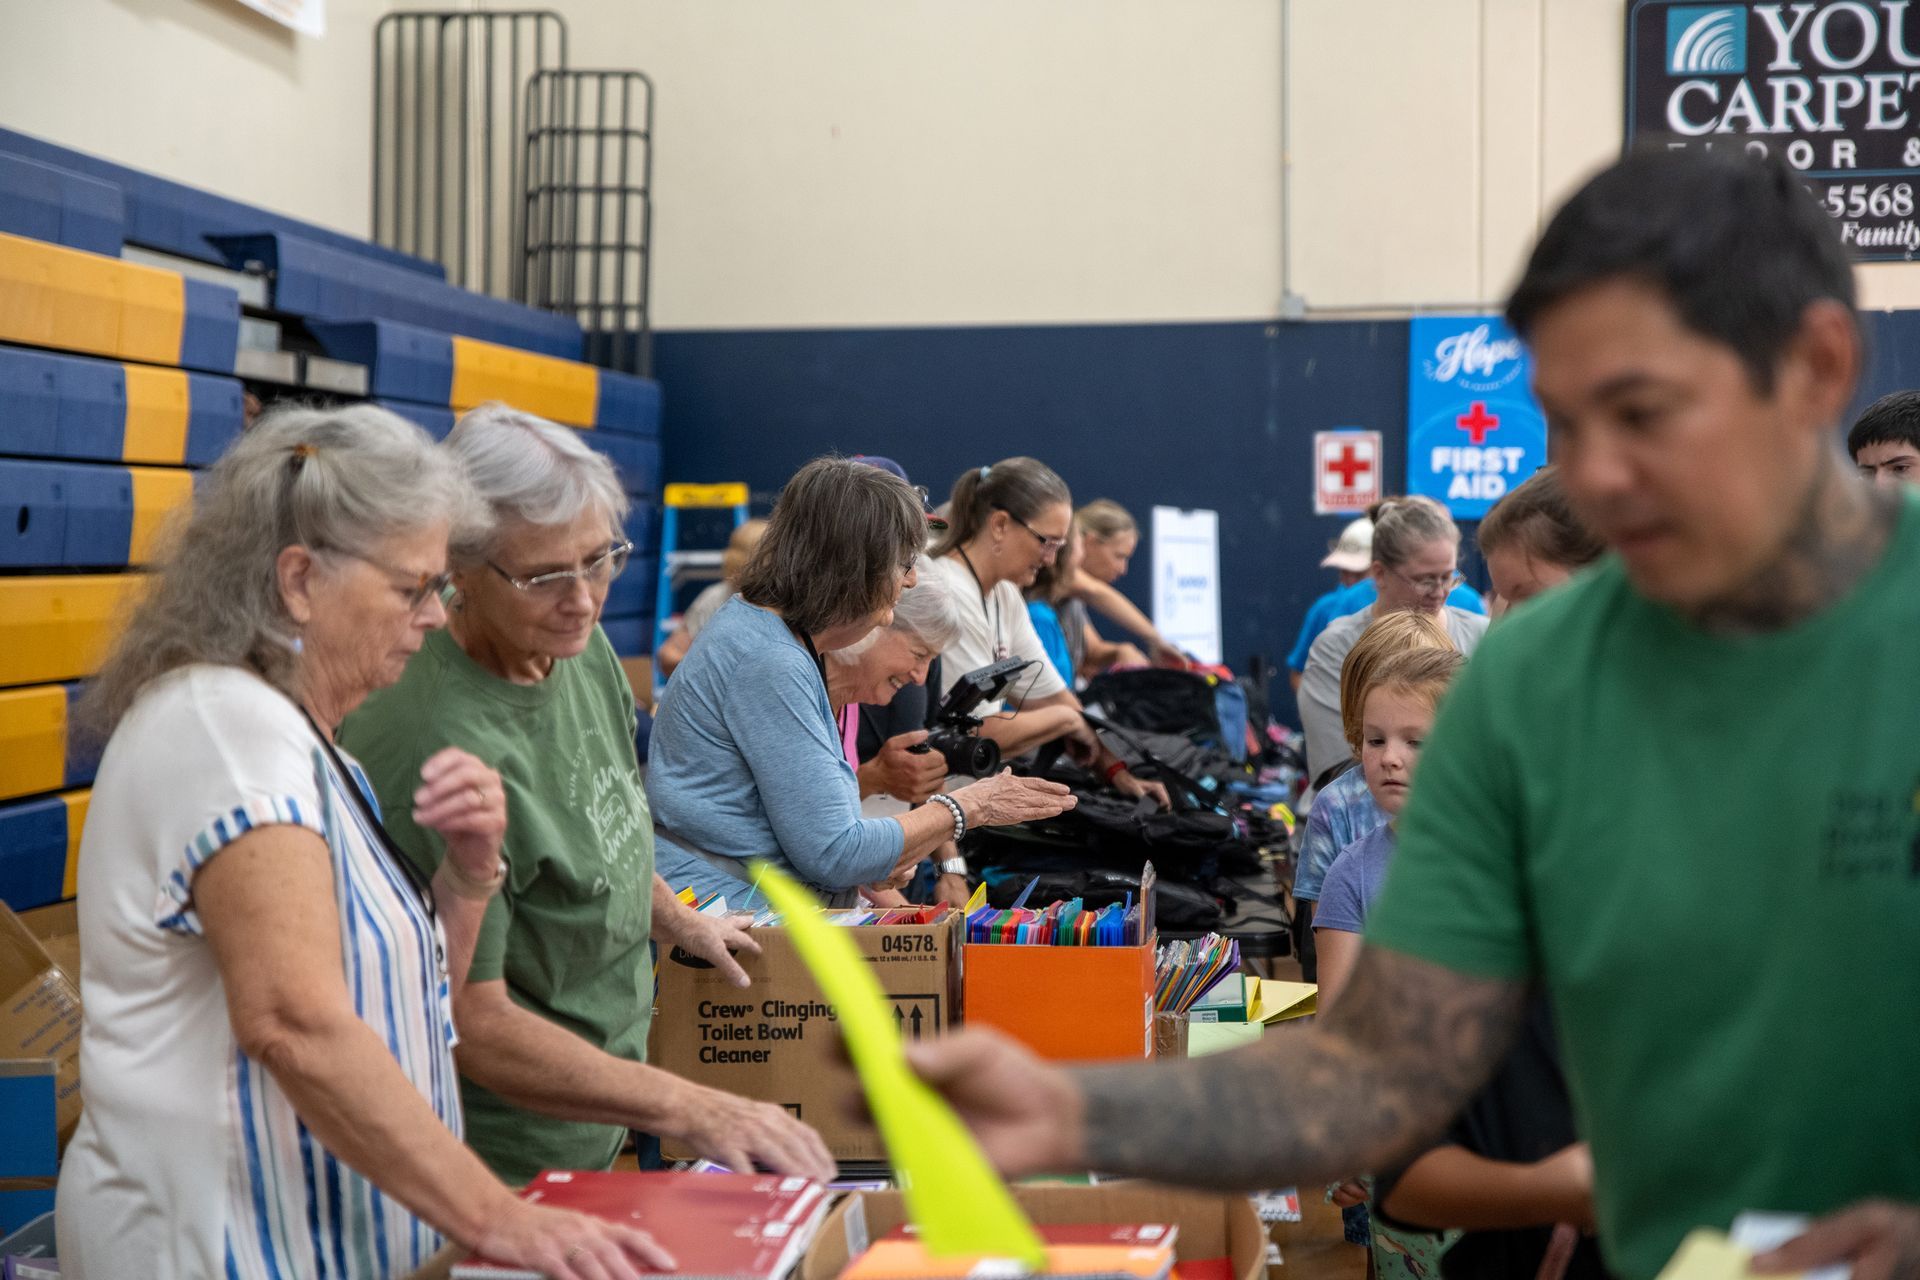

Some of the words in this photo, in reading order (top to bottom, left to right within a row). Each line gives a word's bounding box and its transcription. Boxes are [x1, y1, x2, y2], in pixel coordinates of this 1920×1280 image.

[1431, 446, 1525, 474] FIRST
[1447, 474, 1507, 499] AID
[881, 934, 938, 953] 04578.
[761, 1000, 838, 1022] Clinging
[698, 1023, 753, 1041] Toilet
[757, 1022, 803, 1040] Bowl
[699, 1045, 771, 1064] Cleaner
